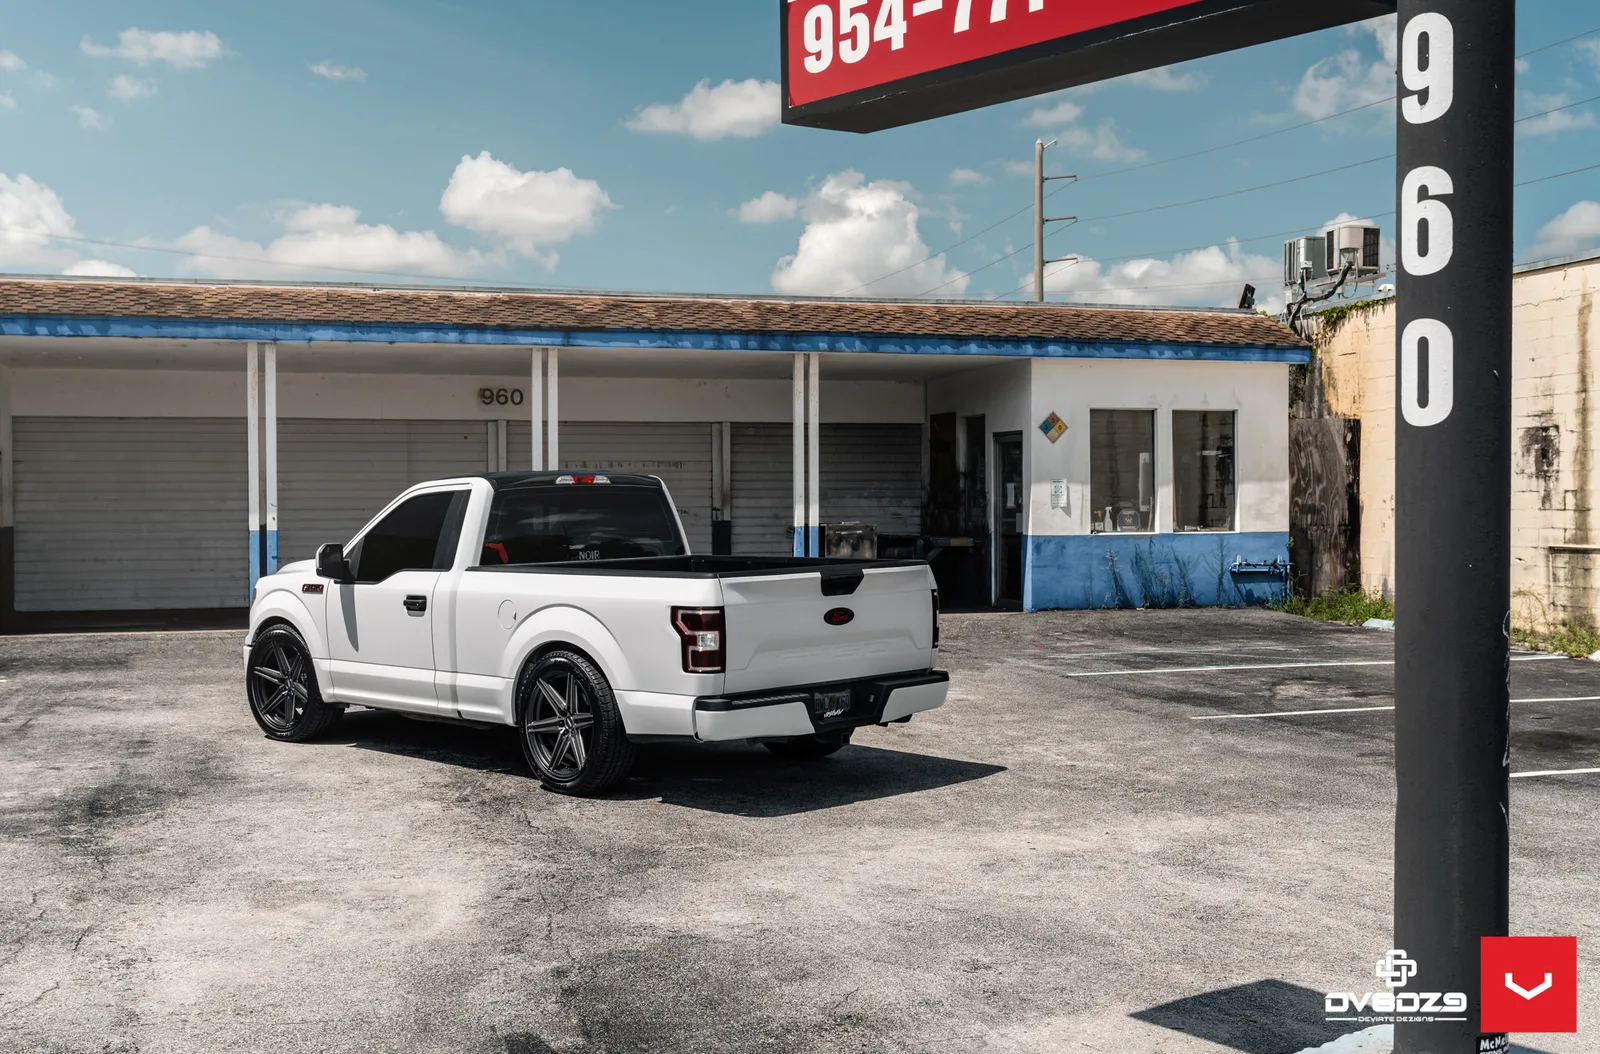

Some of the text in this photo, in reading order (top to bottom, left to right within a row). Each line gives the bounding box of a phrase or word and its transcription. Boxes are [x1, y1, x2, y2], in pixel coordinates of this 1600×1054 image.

[803, 0, 1044, 74] 954-7
[1401, 12, 1454, 427] 960
[481, 388, 524, 405] 960
[578, 550, 600, 560] NOIR
